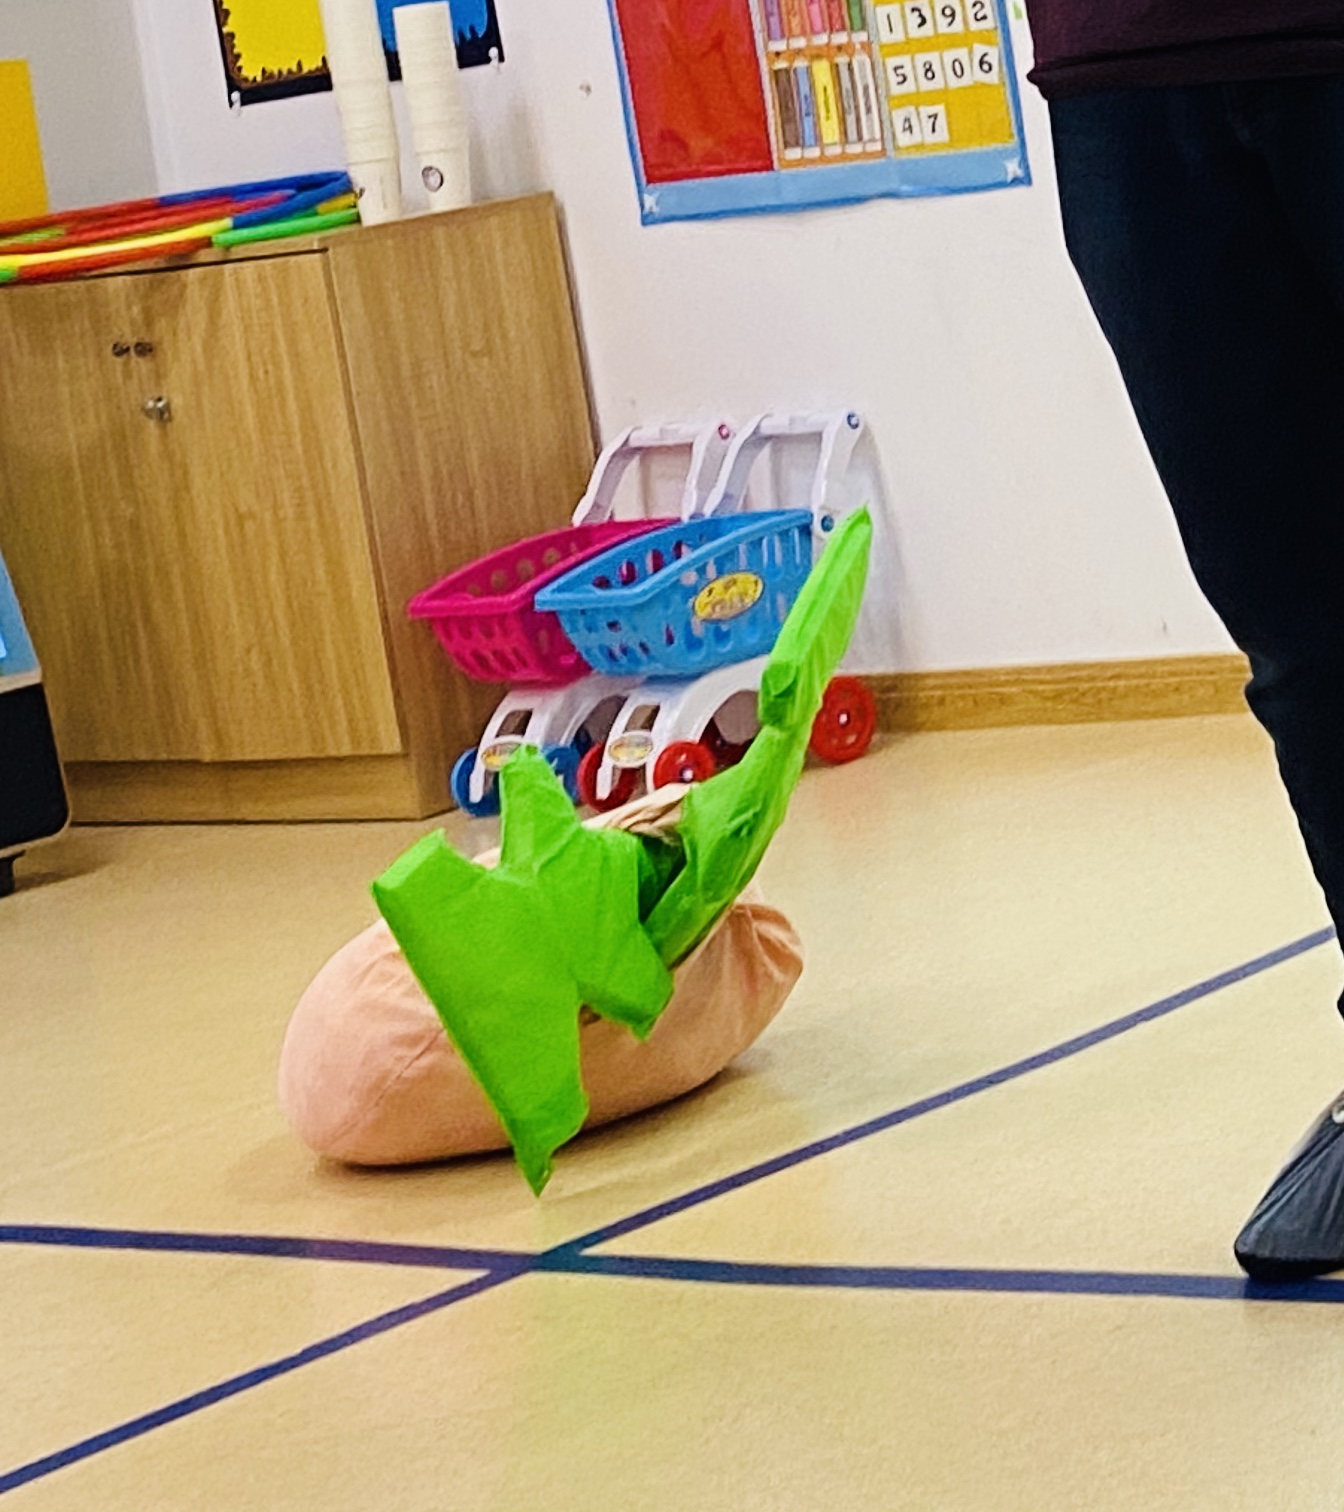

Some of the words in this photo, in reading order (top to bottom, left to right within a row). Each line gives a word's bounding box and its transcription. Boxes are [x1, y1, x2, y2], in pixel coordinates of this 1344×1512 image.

[886, 13, 894, 34] 1
[911, 6, 927, 28] 3
[941, 4, 956, 28] 9
[971, 0, 988, 22] 2
[893, 65, 907, 86] 5
[922, 60, 936, 81] 8
[951, 58, 965, 79] 0
[978, 52, 993, 74] 6
[901, 116, 914, 136] 4
[927, 112, 939, 134] 7
